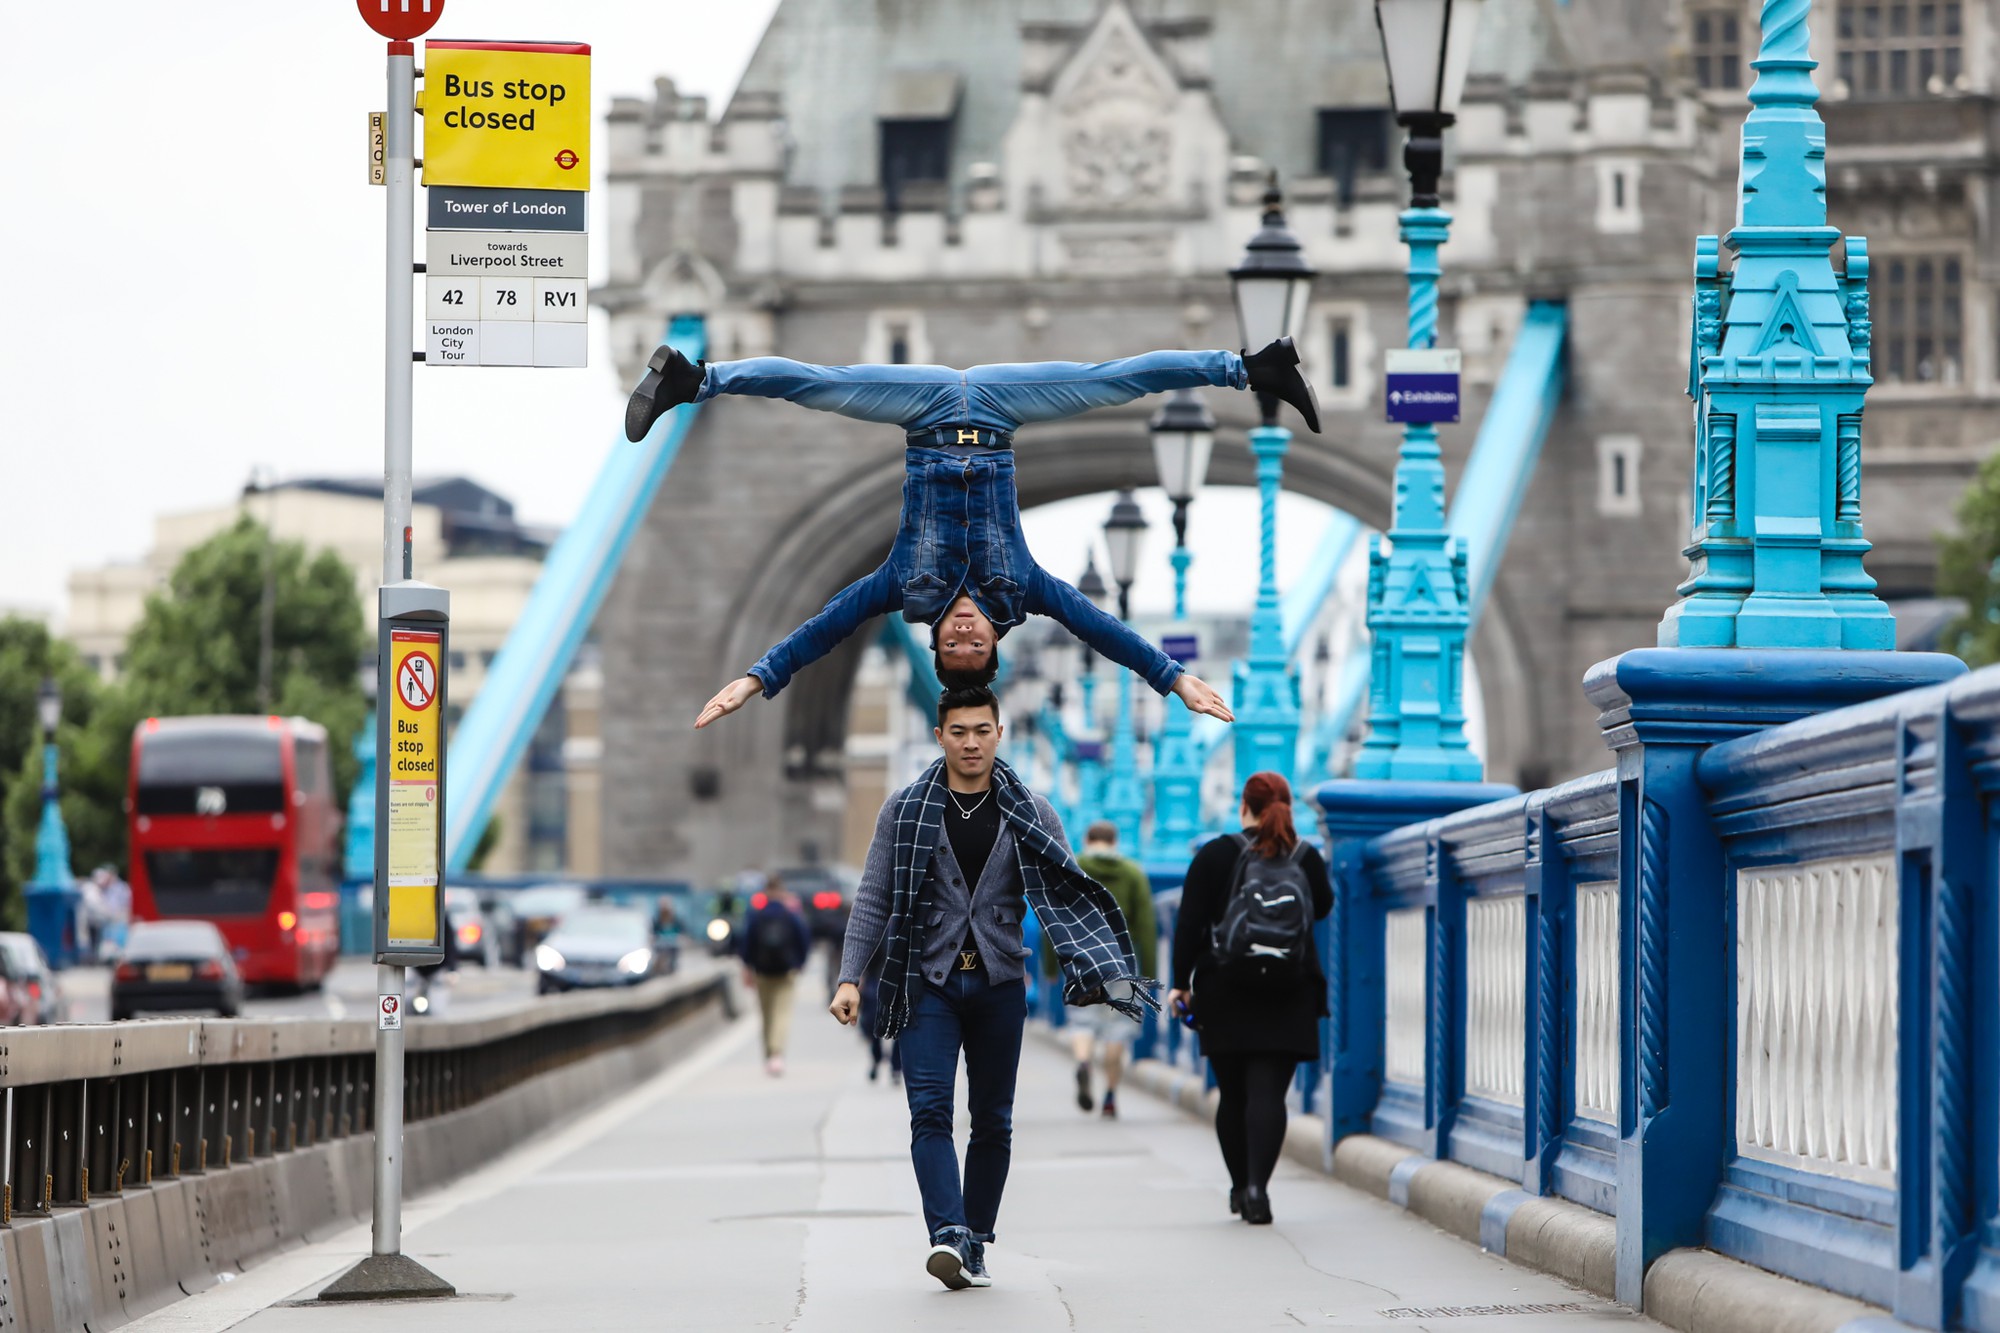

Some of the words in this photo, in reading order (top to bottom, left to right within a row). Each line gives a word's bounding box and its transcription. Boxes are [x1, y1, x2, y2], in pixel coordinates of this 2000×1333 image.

[445, 74, 494, 98] Bus
[503, 79, 566, 107] stop
[443, 106, 535, 131] closed
[444, 200, 489, 213] Tower
[493, 201, 509, 214] of
[512, 202, 566, 215] London
[487, 242, 528, 252] towards
[450, 253, 517, 269] Liverpool
[520, 255, 564, 268] Street
[442, 290, 464, 305] 42
[496, 290, 517, 306] 78
[544, 291, 576, 307] RV1
[432, 325, 474, 335] London
[441, 337, 464, 350] City
[440, 350, 465, 360] Tour
[398, 719, 419, 734] Bus
[397, 740, 424, 756] stop
[397, 757, 435, 772] closed
